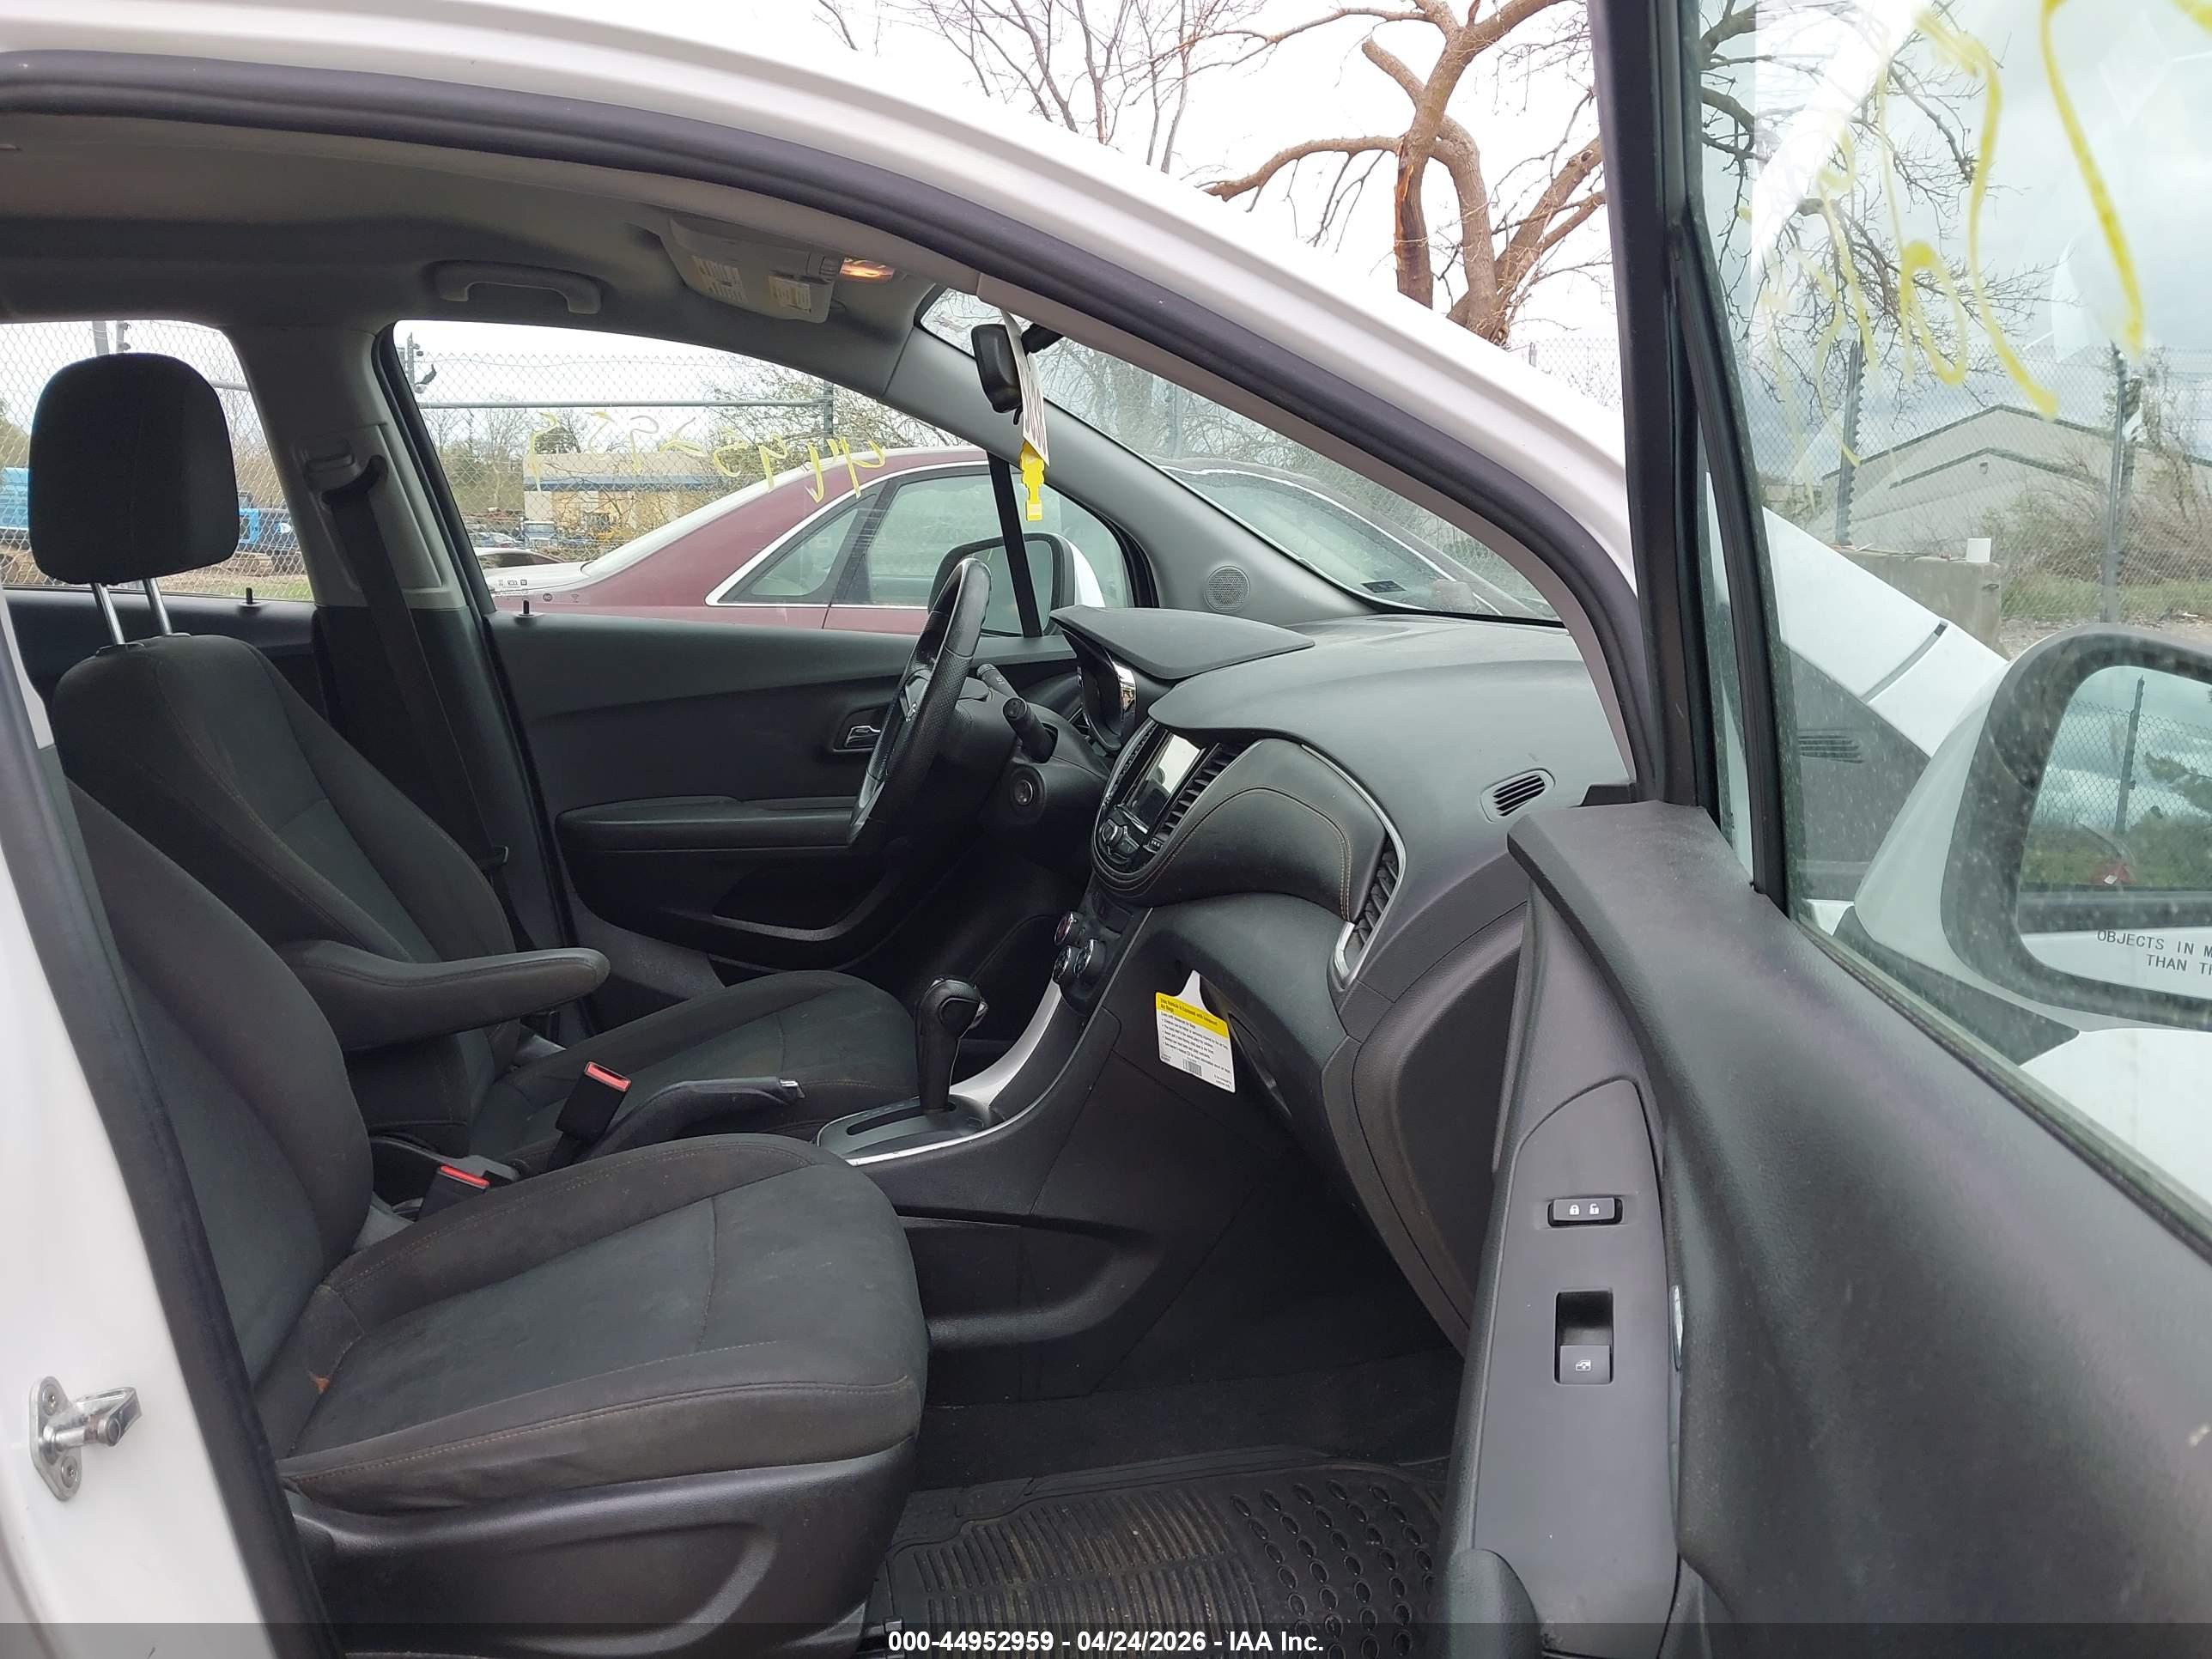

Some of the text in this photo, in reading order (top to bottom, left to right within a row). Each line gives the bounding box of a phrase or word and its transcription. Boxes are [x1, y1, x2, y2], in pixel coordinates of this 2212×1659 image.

[2097, 930, 2165, 951] OBJECTS
[2177, 940, 2194, 955] IN
[2146, 954, 2187, 971] THAN
